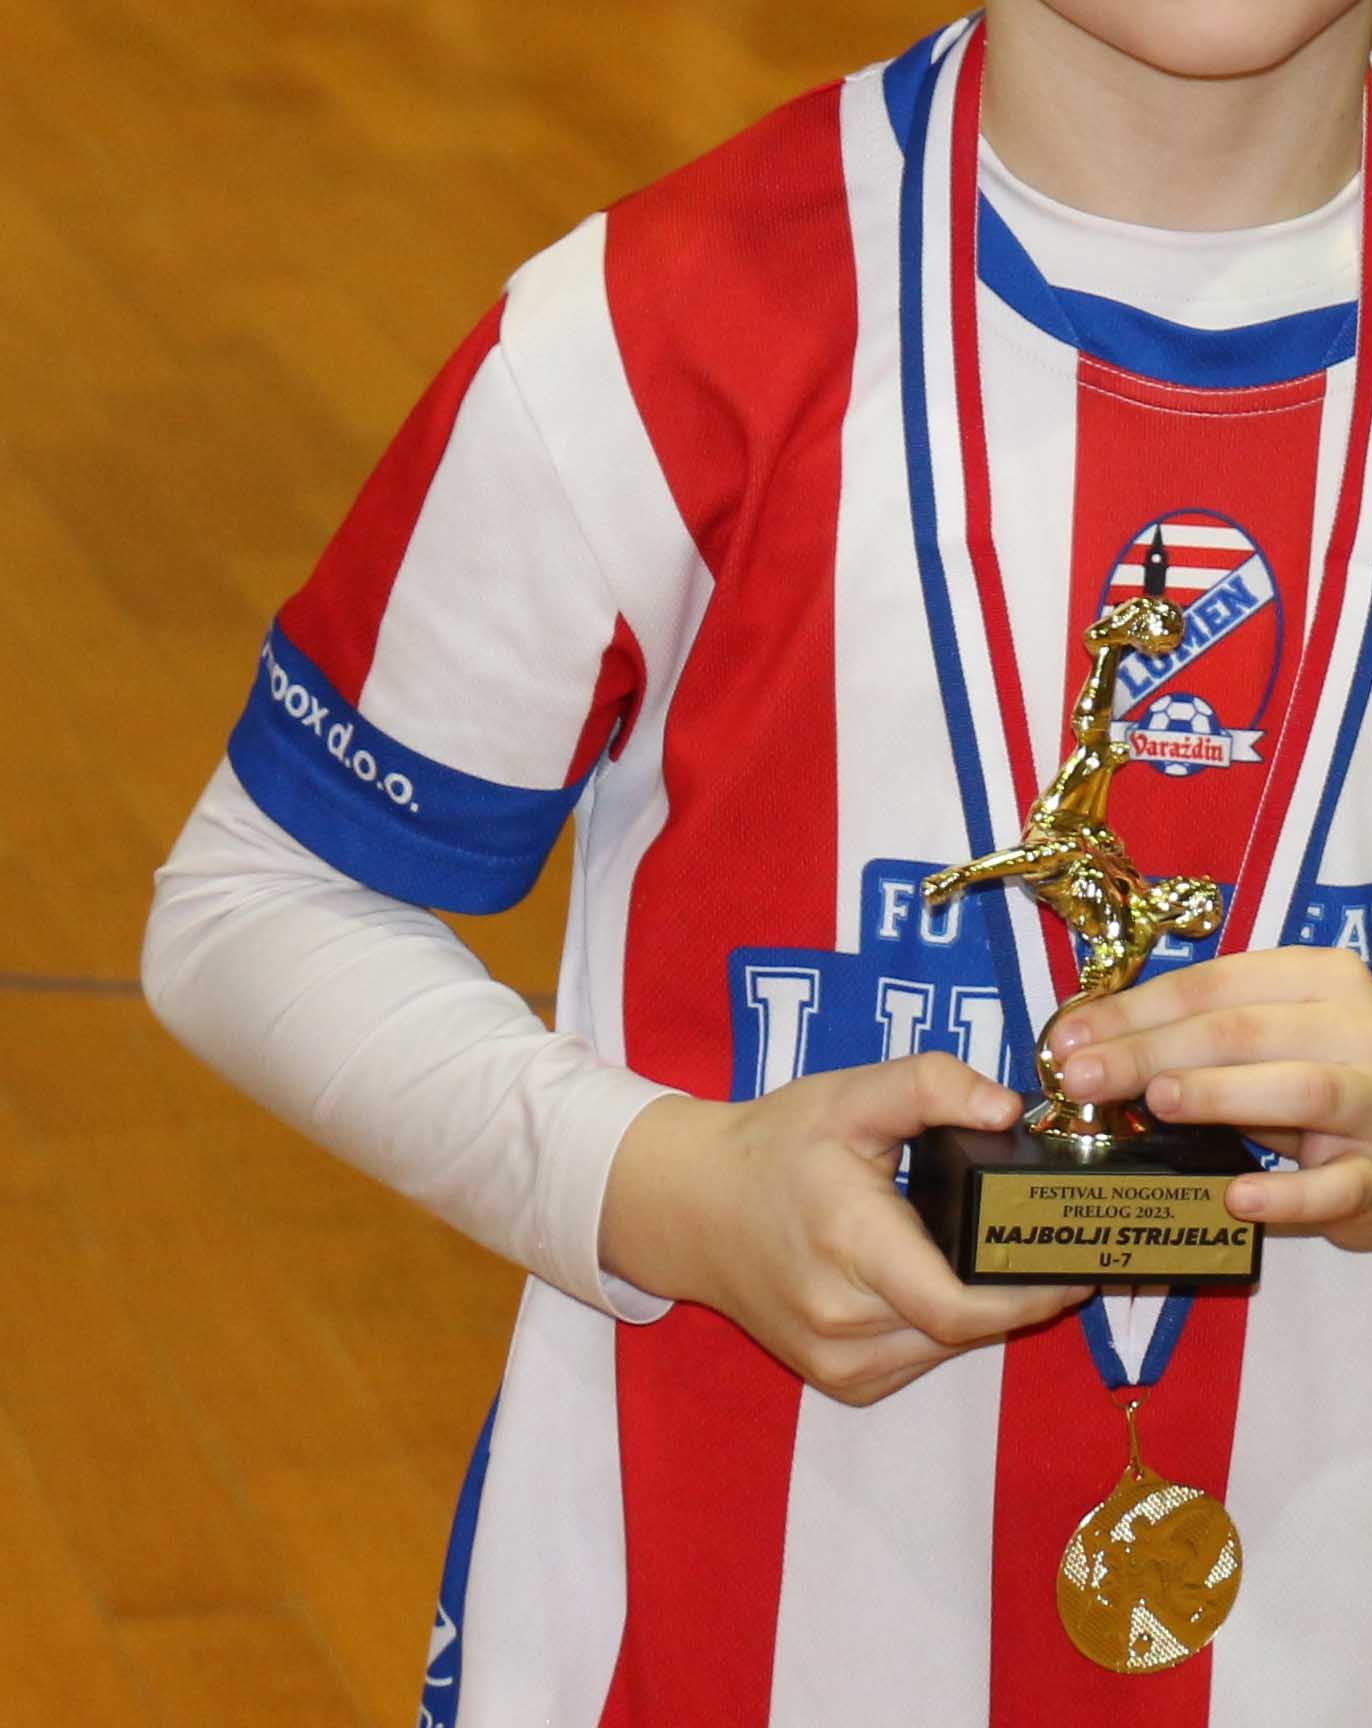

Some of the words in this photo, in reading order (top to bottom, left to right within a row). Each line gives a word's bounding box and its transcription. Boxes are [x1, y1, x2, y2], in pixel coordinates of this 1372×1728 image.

[327, 723, 418, 813] d.o.o.
[1029, 1186, 1108, 1200] FESTIVAL
[1111, 1186, 1211, 1201] NOGOMETA
[1062, 1205, 1131, 1218] PRELOG
[1135, 1205, 1175, 1219] 2023.
[985, 1225, 1111, 1245] NAJBOLJI
[1116, 1227, 1249, 1246] STRIJELAC
[1100, 1252, 1133, 1267] U-7
